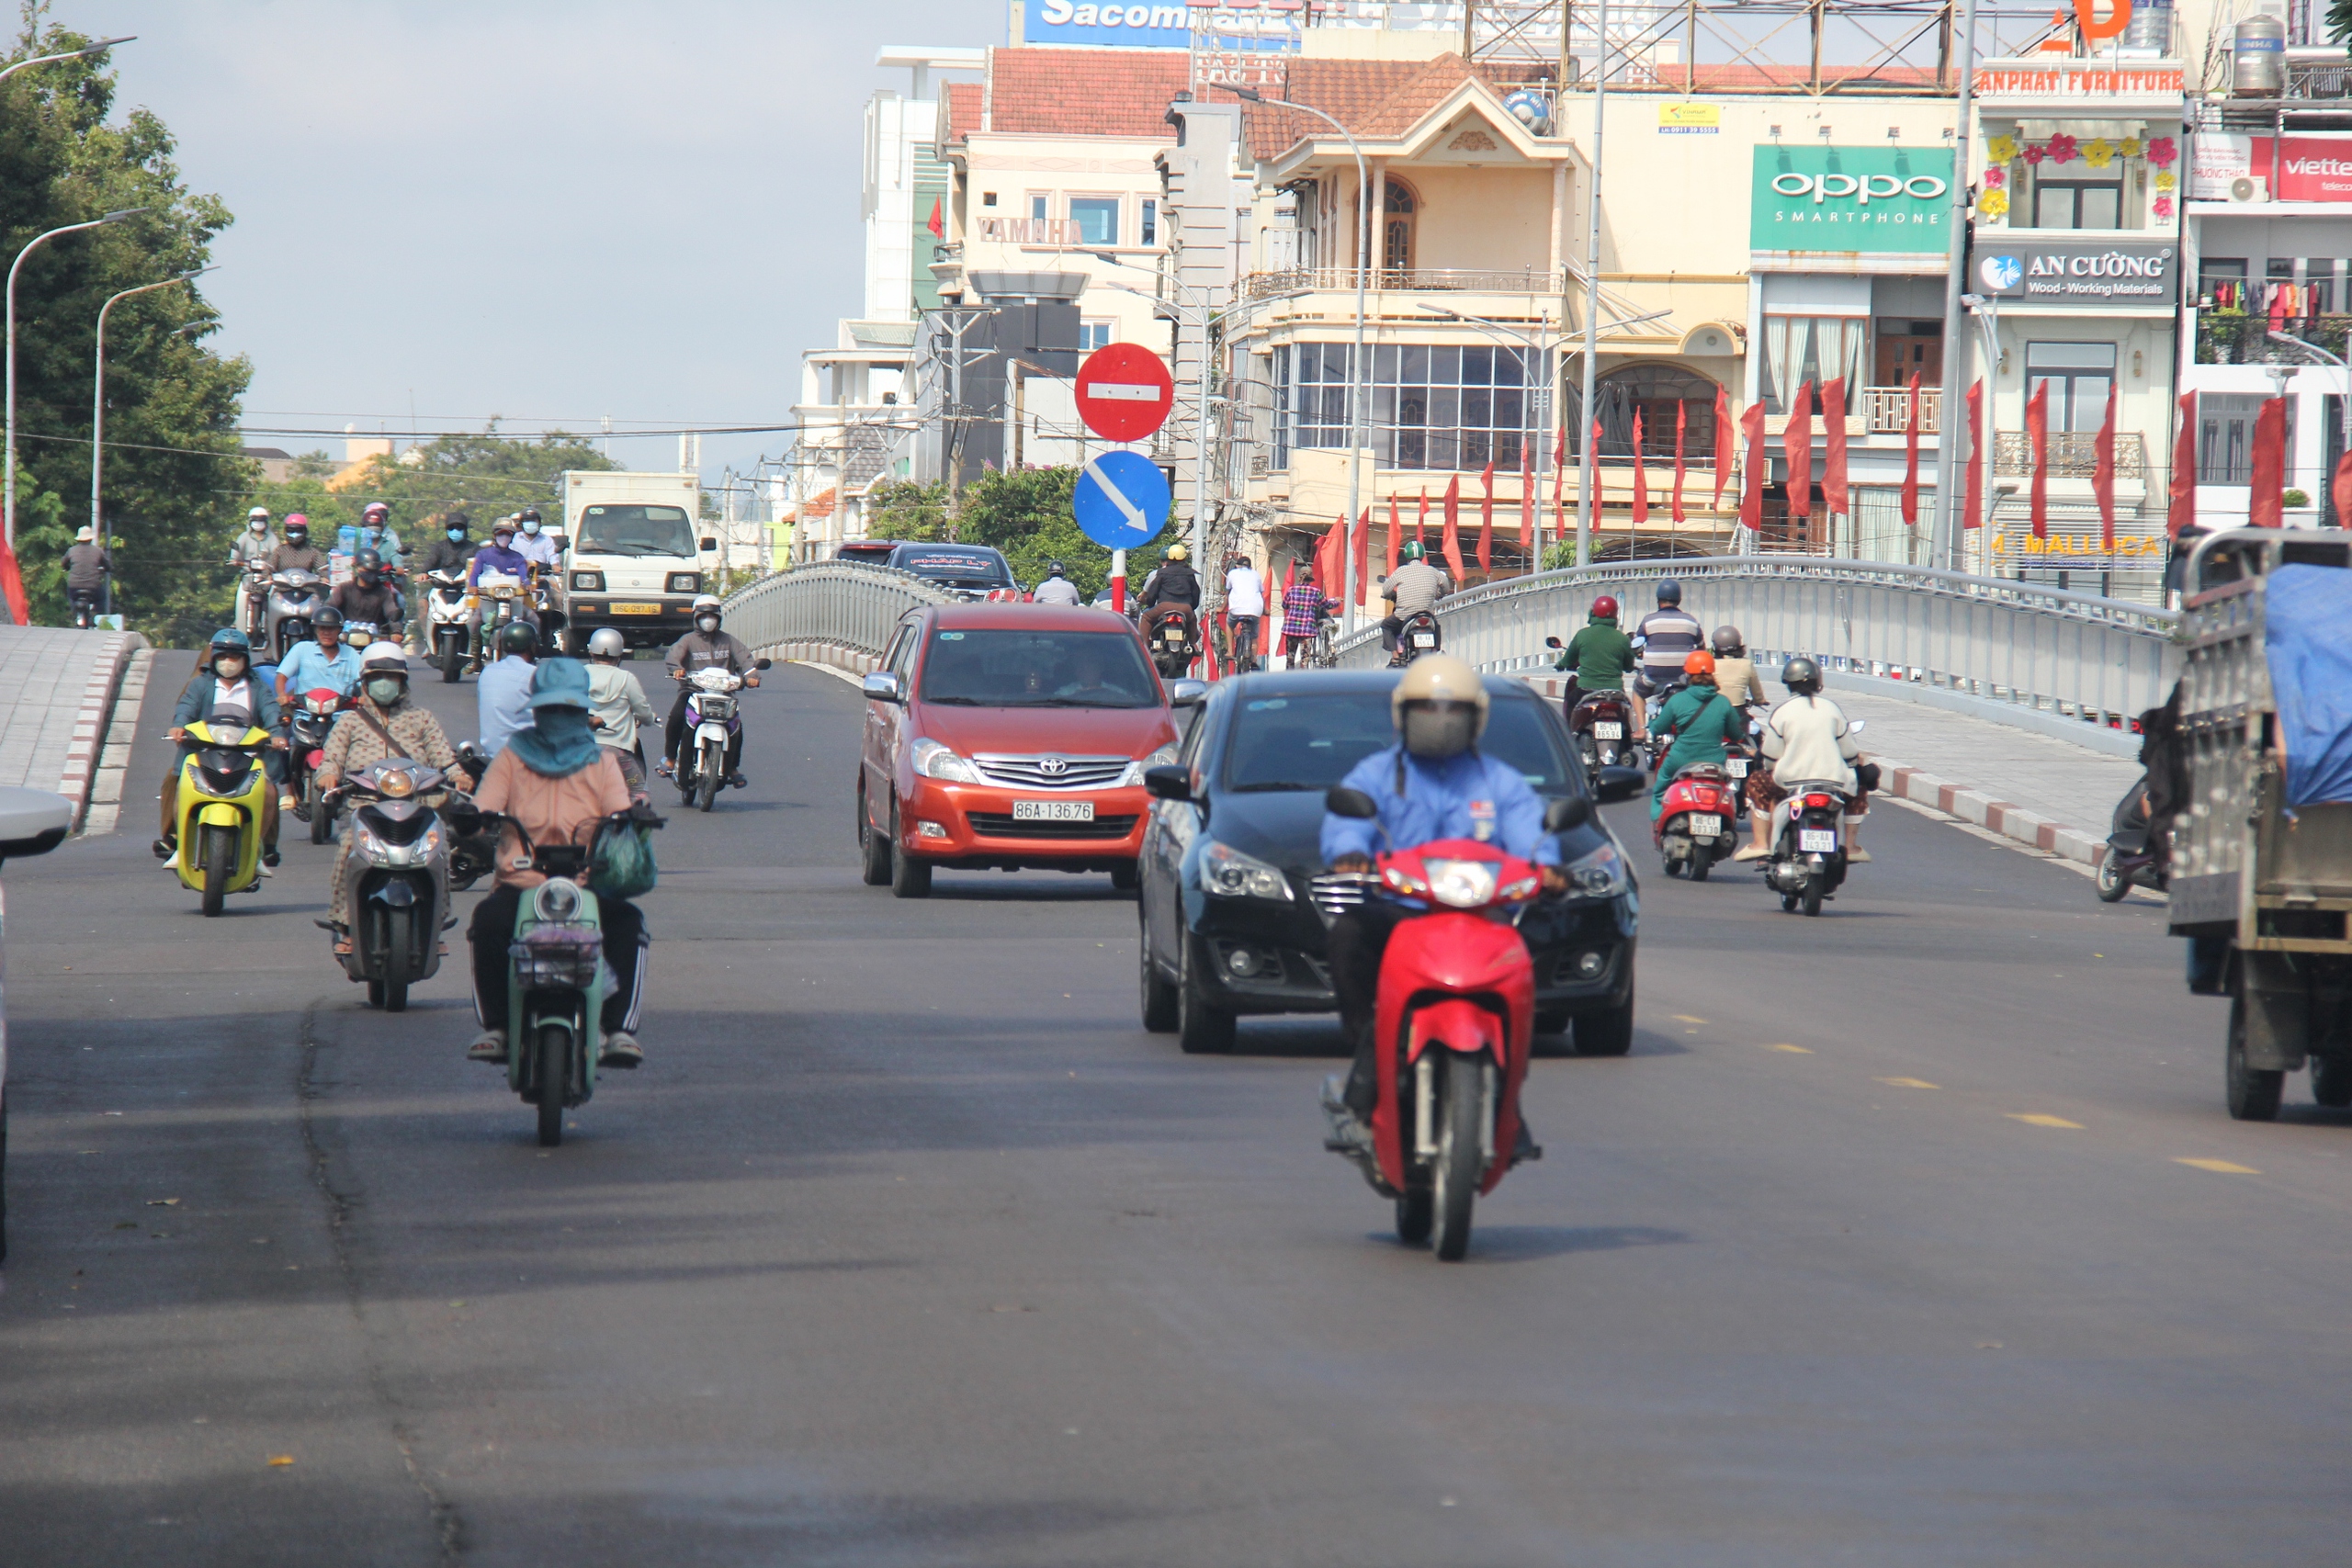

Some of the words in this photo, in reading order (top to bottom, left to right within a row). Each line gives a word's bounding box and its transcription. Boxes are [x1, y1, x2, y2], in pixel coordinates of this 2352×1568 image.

[1979, 71, 2060, 91] ANPHAT
[2068, 70, 2184, 91] FURNITURE
[1775, 210, 1939, 223] SMARTPHONE
[976, 217, 1083, 245] YAMAHA
[2029, 256, 2066, 276] AN
[2113, 283, 2164, 295] Materials
[2025, 534, 2160, 556] MALLOCA
[1015, 803, 1091, 819] 86A-136.76
